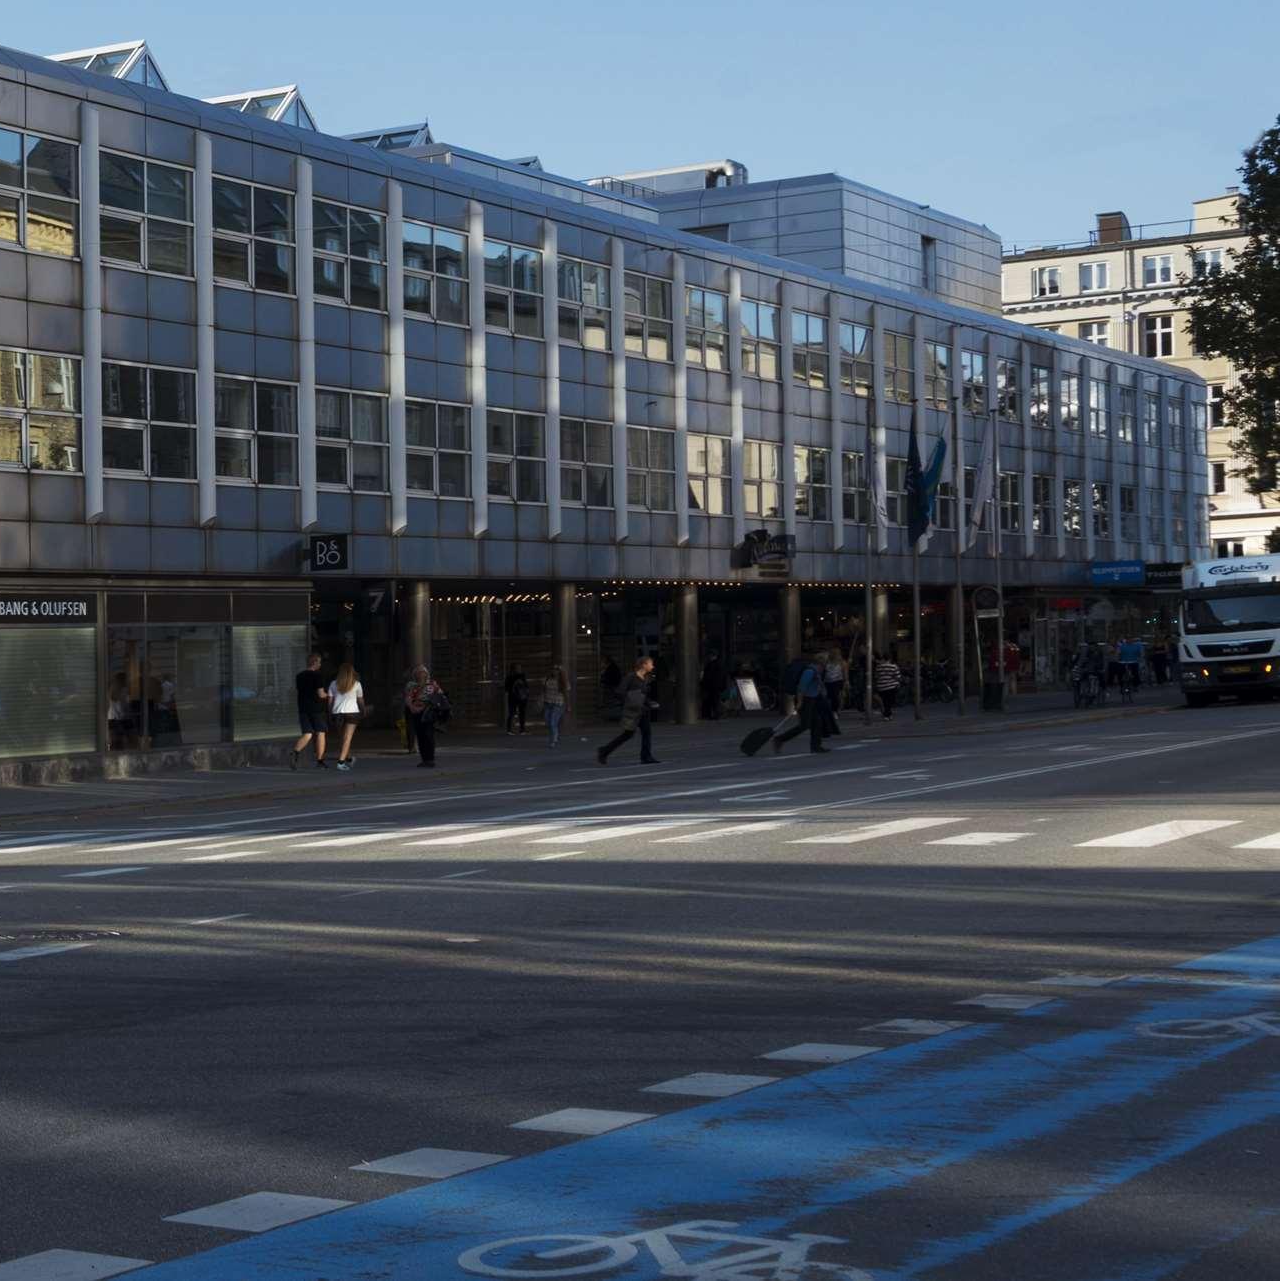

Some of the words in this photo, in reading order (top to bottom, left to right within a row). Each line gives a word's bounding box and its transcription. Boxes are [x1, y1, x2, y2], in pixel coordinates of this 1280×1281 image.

[1208, 563, 1269, 575] Carlsberg
[31, 601, 39, 616] &
[40, 601, 87, 616] OLUFSEN
